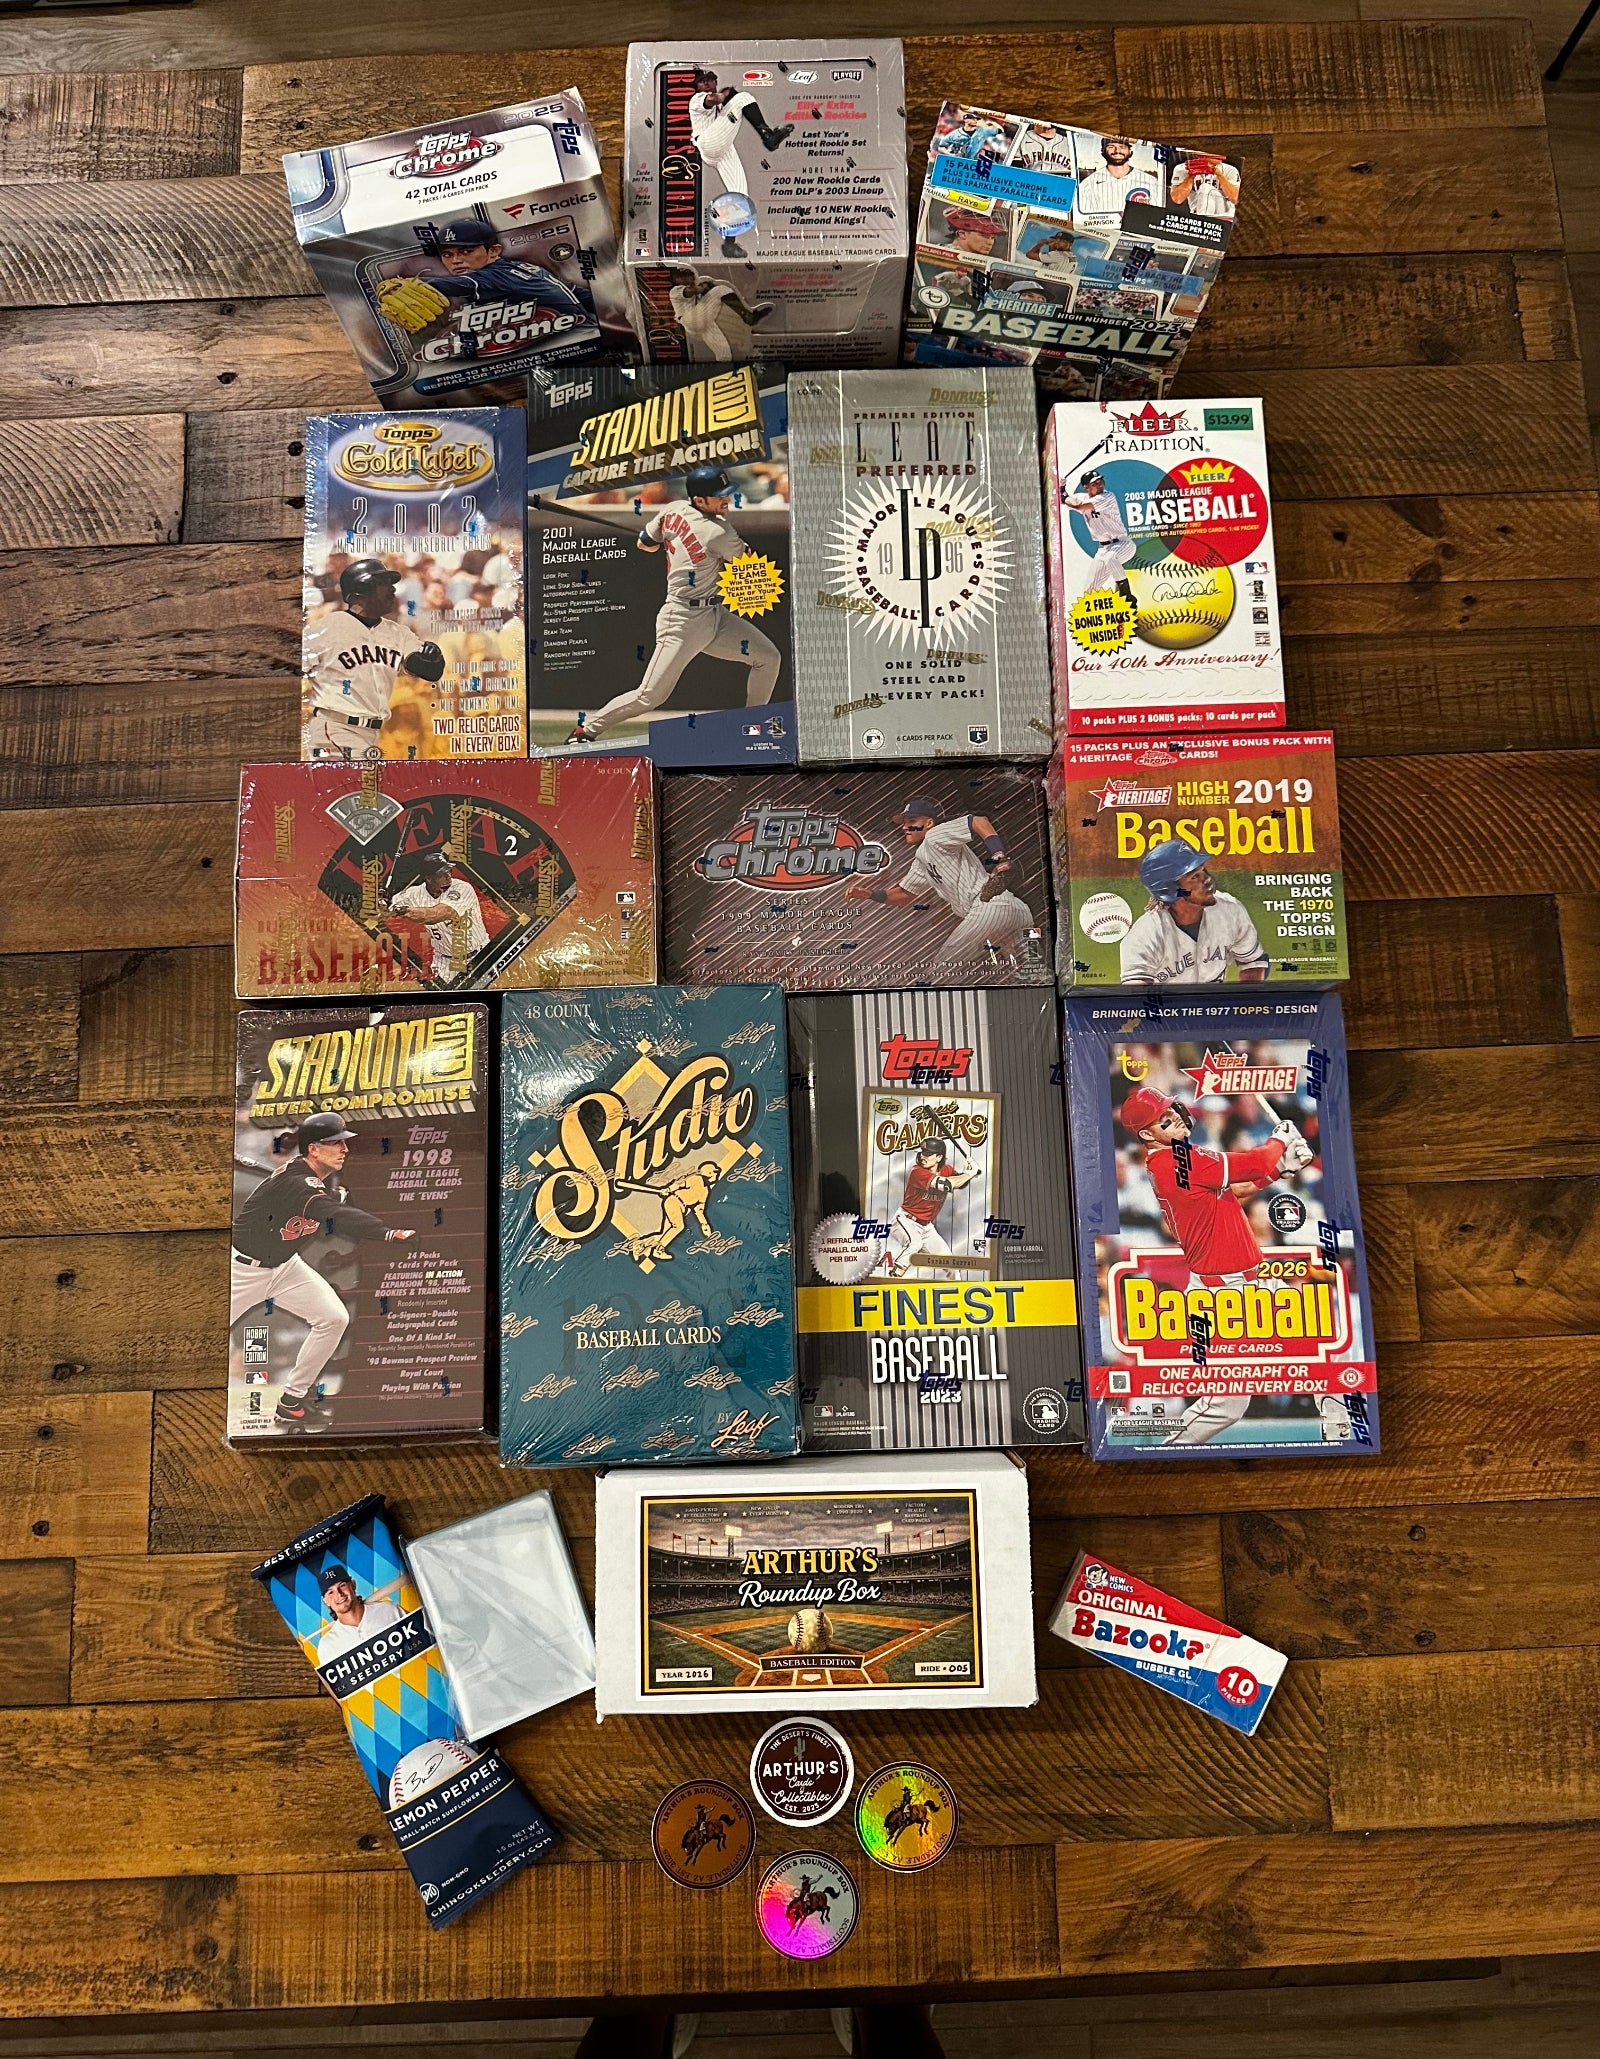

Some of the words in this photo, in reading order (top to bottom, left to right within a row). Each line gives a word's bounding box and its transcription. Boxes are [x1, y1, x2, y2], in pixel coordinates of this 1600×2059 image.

[788, 71, 818, 84] Leaf
[833, 71, 861, 81] PLAYOFF
[504, 103, 564, 124] 2025
[666, 73, 696, 155] ROOKIES
[414, 131, 472, 154] Topps
[393, 140, 497, 177] Chrome
[405, 189, 420, 200] 42
[423, 180, 457, 198] TOTAL
[459, 171, 497, 190] CARDS
[773, 177, 791, 185] 200
[794, 177, 813, 185] New
[817, 176, 850, 185] Rookie
[852, 176, 880, 184] Cards
[942, 175, 962, 186] BLUE
[964, 179, 998, 194] SPARKLE
[1000, 185, 1038, 201] PARALLEL
[1040, 193, 1067, 206] CARDS
[770, 188, 792, 196] from
[795, 187, 822, 196] DLP's
[825, 187, 849, 195] 2003
[852, 186, 884, 196] Lineup
[529, 191, 598, 216] Fanatics
[666, 179, 695, 254] TRADED
[999, 299, 1056, 316] HERITAGE
[1057, 311, 1080, 321] HIGH
[1083, 314, 1129, 327] NUMBER
[1129, 320, 1182, 333] 2023
[942, 309, 1179, 357] BASEBALL
[545, 379, 593, 408] Topps
[570, 380, 705, 467] STADIUM
[854, 412, 915, 420] PREMIERE
[1109, 417, 1192, 434] FLEER
[1208, 414, 1250, 425] $13.99
[380, 427, 435, 439] Topps
[1101, 436, 1204, 455] TRADITION
[342, 443, 413, 475] Gold
[414, 442, 476, 478] Label
[563, 461, 628, 489] CAPTURE
[634, 455, 665, 474] THE
[671, 430, 760, 466] ACTION!
[857, 465, 976, 477] PREFERRED
[1190, 471, 1225, 482] FLEER
[1124, 492, 1145, 501] 2003
[1147, 489, 1177, 498] MAJOR
[1179, 487, 1212, 496] LEAGUE
[352, 496, 477, 536] 2002
[1126, 493, 1257, 527] BASEBALL
[543, 527, 573, 538] 2001
[885, 661, 913, 670] ONE
[920, 660, 962, 669] SOLID
[1071, 657, 1101, 672] Our
[1108, 656, 1148, 669] 40th
[1155, 648, 1280, 667] Anniversary!
[882, 676, 920, 685] STEEL
[929, 675, 966, 684] CARD
[888, 691, 932, 700] EVERY
[941, 690, 984, 699] PACK!
[433, 720, 455, 733] TWO
[458, 717, 487, 732] RELIC
[489, 716, 520, 731] CARDS
[1082, 716, 1090, 725] 10
[1093, 716, 1116, 725] packs
[1118, 716, 1137, 724] PLUS
[1148, 714, 1174, 723] BONUS
[1206, 712, 1215, 720] 10
[1217, 712, 1239, 720] cards
[1241, 712, 1255, 720] per
[1257, 710, 1276, 719] pack
[451, 738, 463, 752] IN
[466, 735, 495, 751] EVERY
[498, 733, 520, 750] BOX!
[1116, 789, 1170, 804] HERITAGE
[1178, 781, 1228, 795] HIGH
[1234, 779, 1312, 804] 2019
[1178, 796, 1230, 806] NUMBER
[745, 803, 840, 848] Topps
[1116, 807, 1315, 858] Baseball
[504, 836, 518, 856] 2
[702, 841, 884, 880] Chrome
[1255, 874, 1332, 886] BRINGING
[1290, 887, 1332, 898] BACK
[1263, 900, 1294, 911] THE
[1300, 900, 1334, 910] 1970
[1280, 913, 1332, 923] TOPPS
[1277, 926, 1335, 936] DESIGN
[524, 1006, 541, 1018] 48
[544, 1004, 591, 1018] COUNT
[1092, 1009, 1146, 1019] BRINGING
[1181, 1008, 1202, 1016] THE
[1205, 1007, 1229, 1016] 1977
[1232, 1006, 1269, 1015] TOPPS
[1276, 1005, 1318, 1014] DESIGN
[256, 1019, 428, 1099] STADIUM
[880, 1034, 973, 1081] Topps
[1220, 1069, 1294, 1092] HERITAGE
[249, 1101, 313, 1117] NEVER
[321, 1085, 471, 1112] COMPROMISE
[408, 1125, 449, 1145] Topps
[876, 1114, 988, 1155] GAMERS
[536, 1056, 753, 1239] Studio
[402, 1149, 452, 1167] 1998
[387, 1179, 427, 1189] BASEBALL
[435, 1178, 462, 1187] CARDS
[390, 1170, 422, 1179] MAJOR
[426, 1168, 460, 1178] LEAGUE
[1258, 1261, 1307, 1278] 2026
[853, 1285, 1024, 1327] FINEST
[1124, 1278, 1333, 1341] Baseball
[576, 1329, 660, 1349] BASEBALL
[666, 1326, 721, 1344] CARDS
[871, 1334, 1007, 1384] BASEBALL
[1160, 1367, 1189, 1379] ONE
[1191, 1366, 1282, 1379] AUTOGRAPH
[1284, 1365, 1308, 1377] OR
[1142, 1382, 1184, 1395] RELIC
[1186, 1381, 1226, 1394] CARD
[1228, 1381, 1243, 1393] IN
[1245, 1380, 1290, 1393] EVERY
[1293, 1379, 1327, 1392] BOX!
[717, 1412, 732, 1424] BY
[712, 1410, 780, 1448] Leaf
[742, 1548, 878, 1576] ARTHUR'S
[1109, 1575, 1126, 1584] NEW
[1109, 1581, 1134, 1593] COMICS
[738, 1578, 835, 1607] Roundup
[837, 1578, 880, 1601] Box
[1077, 1589, 1167, 1621] ORIGINAL
[1072, 1608, 1204, 1661] Bazooka
[325, 1621, 419, 1684] CHINOOK
[770, 1658, 817, 1668] BASEBALL
[819, 1657, 856, 1667] EDITION
[350, 1648, 404, 1686] SEEDERY
[661, 1671, 683, 1679] YEAR
[685, 1668, 709, 1679] 2026
[920, 1665, 940, 1673] RIDE
[1226, 1671, 1255, 1698] 10
[1221, 1687, 1247, 1704] PIECES
[762, 1760, 839, 1778] ARTHUR'S
[389, 1798, 438, 1832] LEMON
[442, 1757, 499, 1802] PEPPER
[771, 1790, 832, 1804] Collectibles
[784, 1804, 800, 1812] EST.
[802, 1803, 820, 1812] 2025
[431, 1837, 552, 1918] CHINOOKSEEDERY.COM
